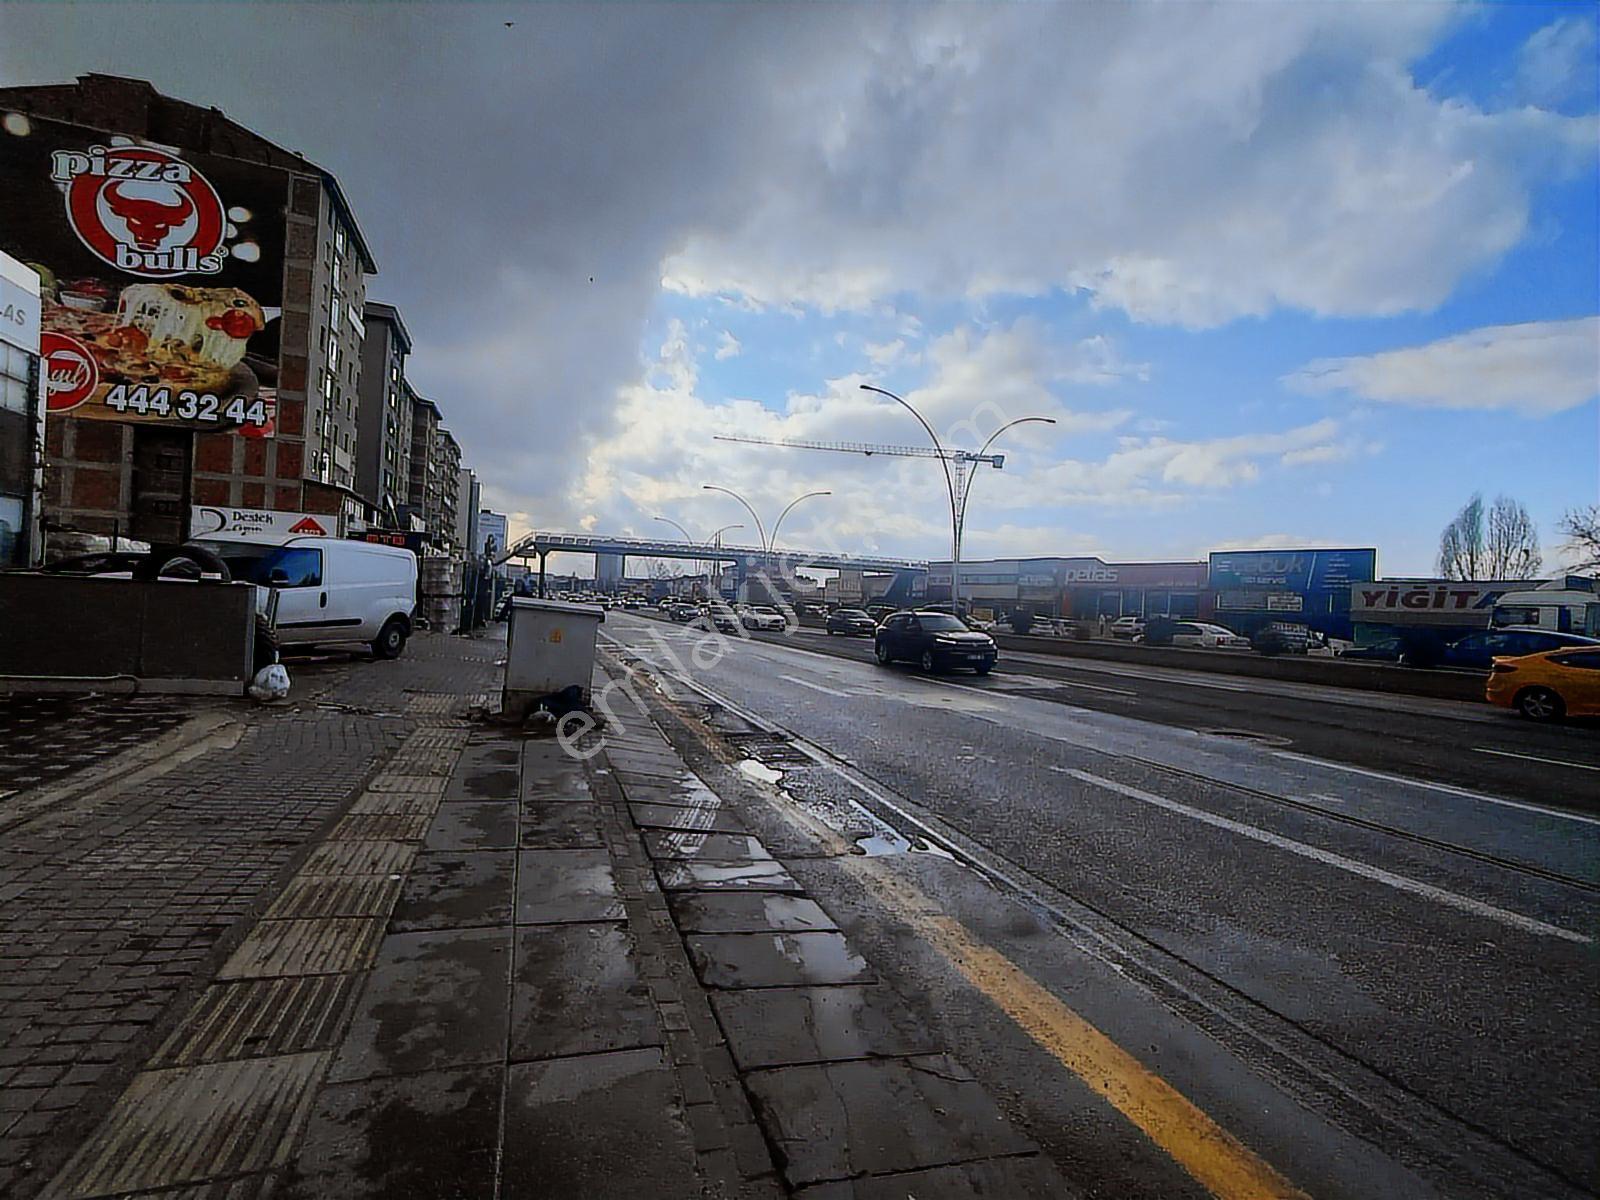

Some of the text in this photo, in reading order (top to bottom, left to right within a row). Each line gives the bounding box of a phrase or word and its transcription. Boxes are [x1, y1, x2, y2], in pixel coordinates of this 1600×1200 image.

[51, 146, 192, 183] pizza
[115, 243, 222, 274] bulls
[0, 304, 26, 326] AS
[106, 385, 265, 426] 444 32 44
